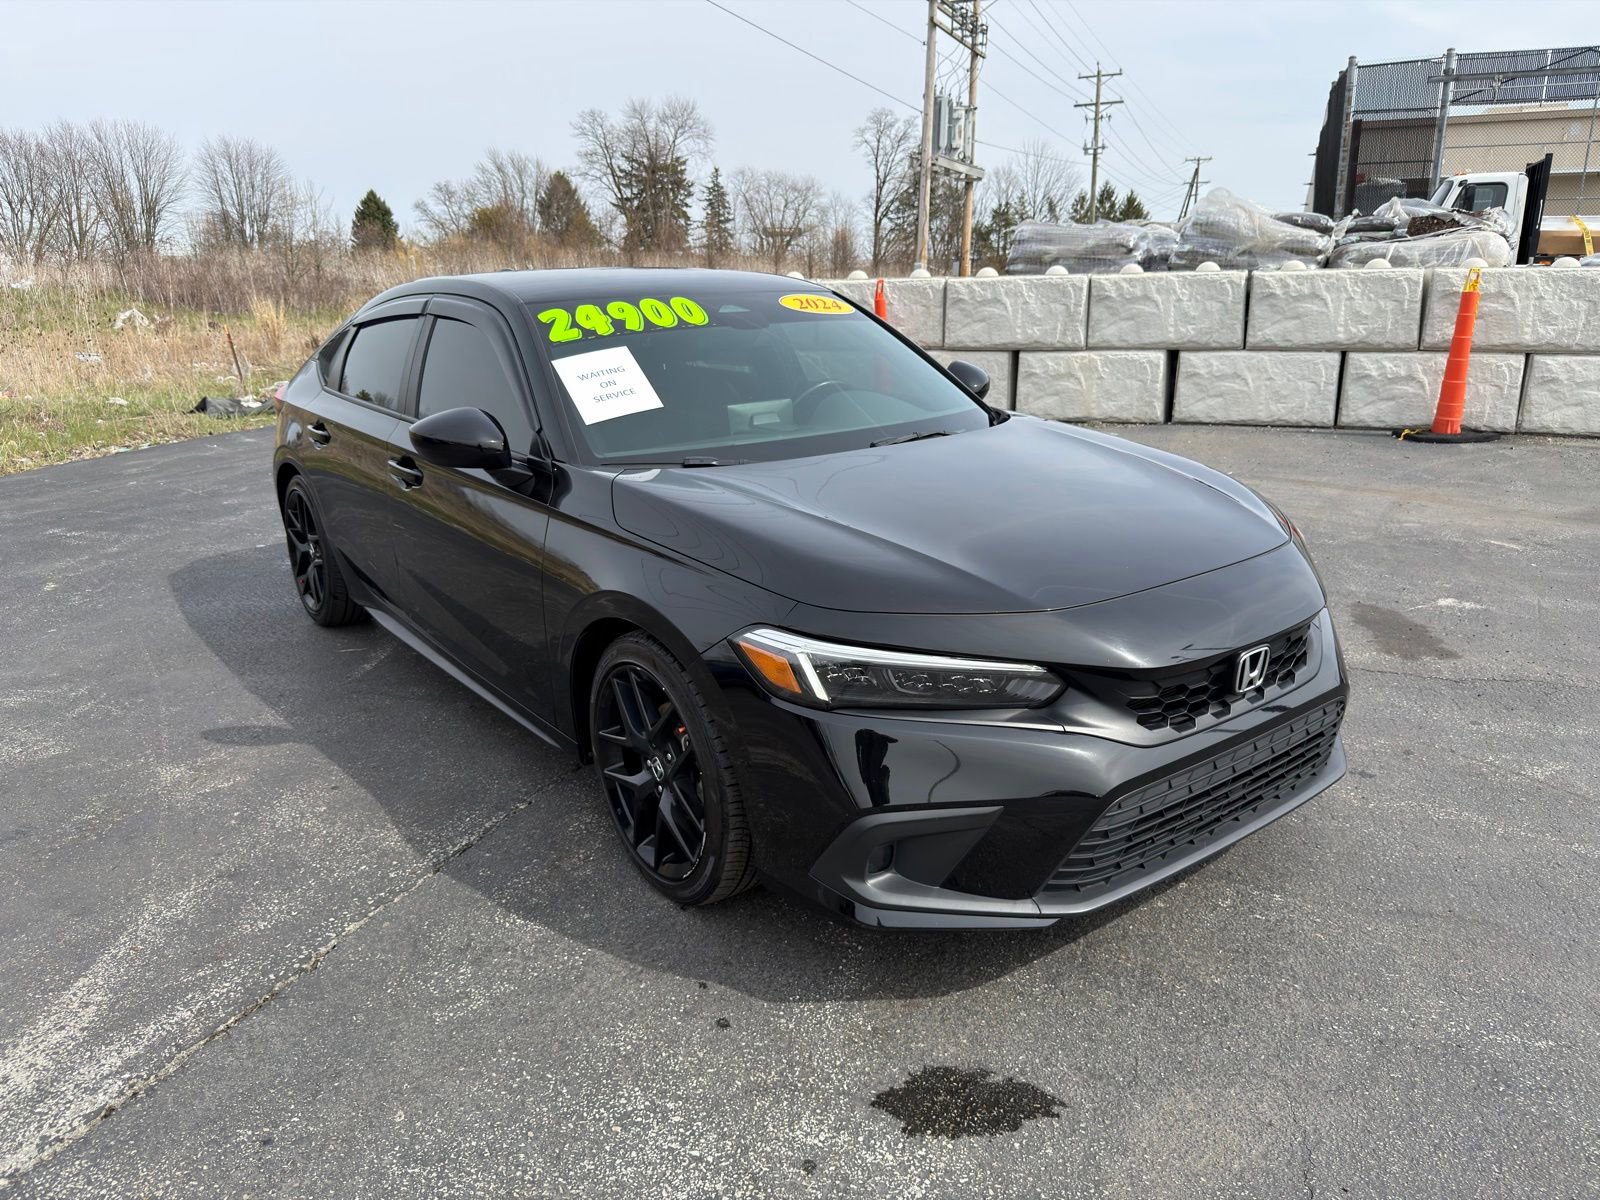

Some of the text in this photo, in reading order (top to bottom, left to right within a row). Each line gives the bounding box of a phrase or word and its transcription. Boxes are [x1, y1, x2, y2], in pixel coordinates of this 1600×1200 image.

[792, 298, 842, 310] 2024
[537, 297, 709, 342] 24900
[577, 365, 626, 381] WAITING
[599, 379, 617, 389] ON
[592, 387, 637, 403] SERVICE
